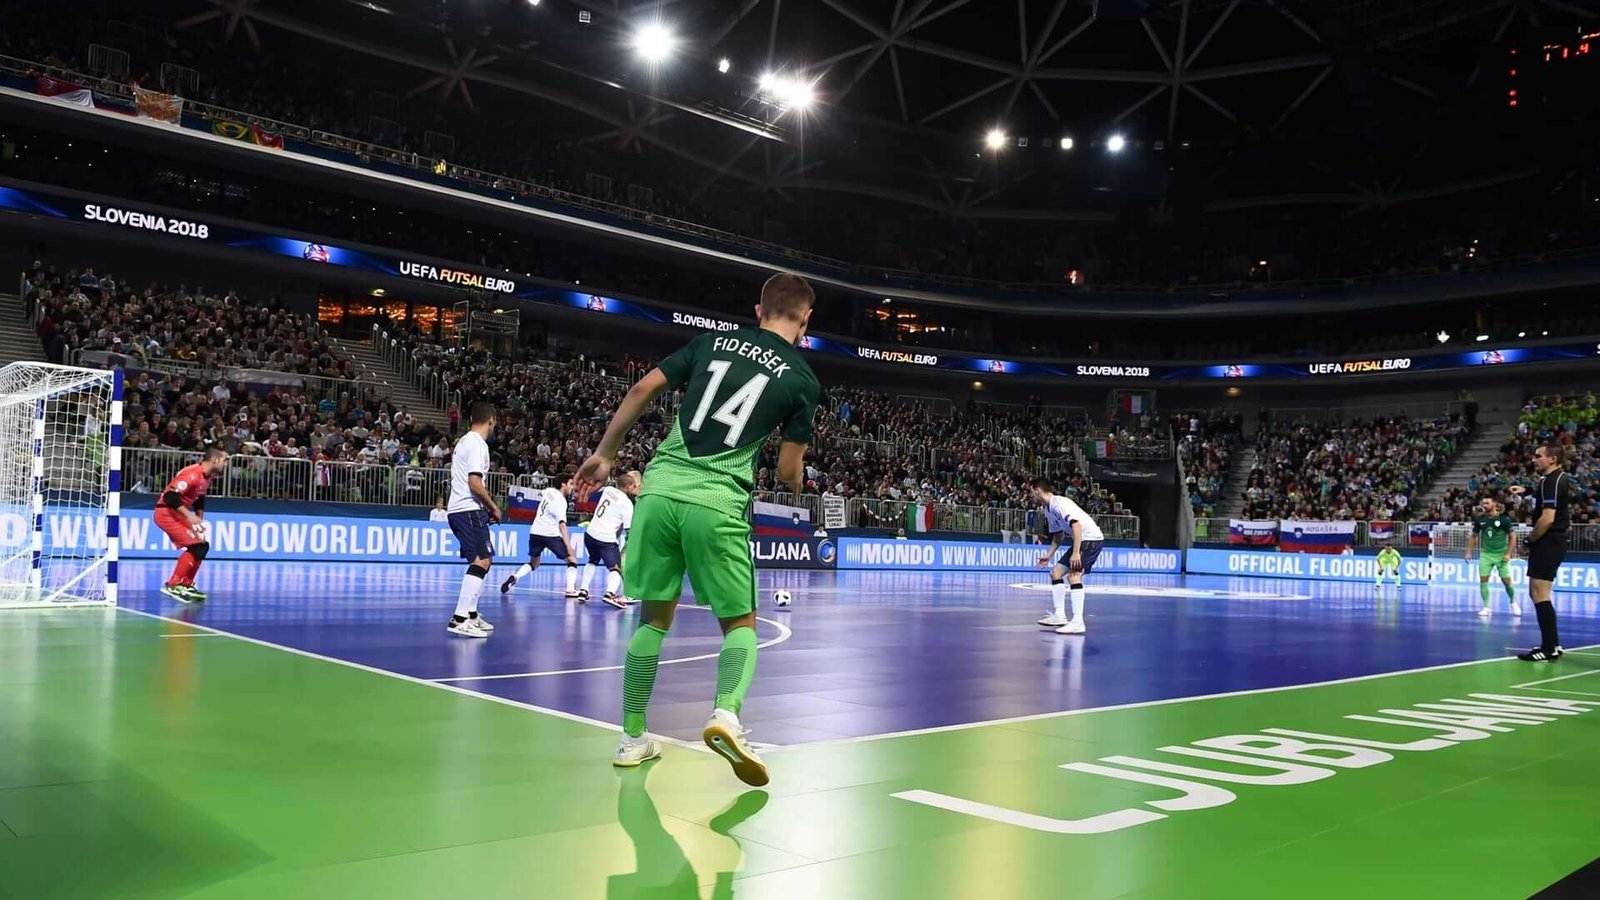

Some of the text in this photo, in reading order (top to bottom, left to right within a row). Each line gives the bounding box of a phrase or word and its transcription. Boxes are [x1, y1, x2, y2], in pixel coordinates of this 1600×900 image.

[84, 204, 209, 239] SLOVENIA 2018
[399, 261, 515, 293] UEFA FUTSAL EURO
[672, 312, 717, 330] SLOVENIA
[713, 336, 792, 379] FIDERŠEK
[858, 346, 938, 366] UEFA FUTSAL EURO
[1309, 358, 1411, 374] UEFA FUTSAL EURO
[1077, 365, 1150, 377] SLOVENIA 2018
[688, 359, 771, 448] 14
[596, 498, 611, 519] 6
[862, 543, 935, 566] MONDO
[1128, 552, 1177, 570] MONDO
[1229, 554, 1304, 575] OFFICIAL
[1553, 566, 1599, 588] EFA
[889, 692, 1600, 834] LJUBLJANA
